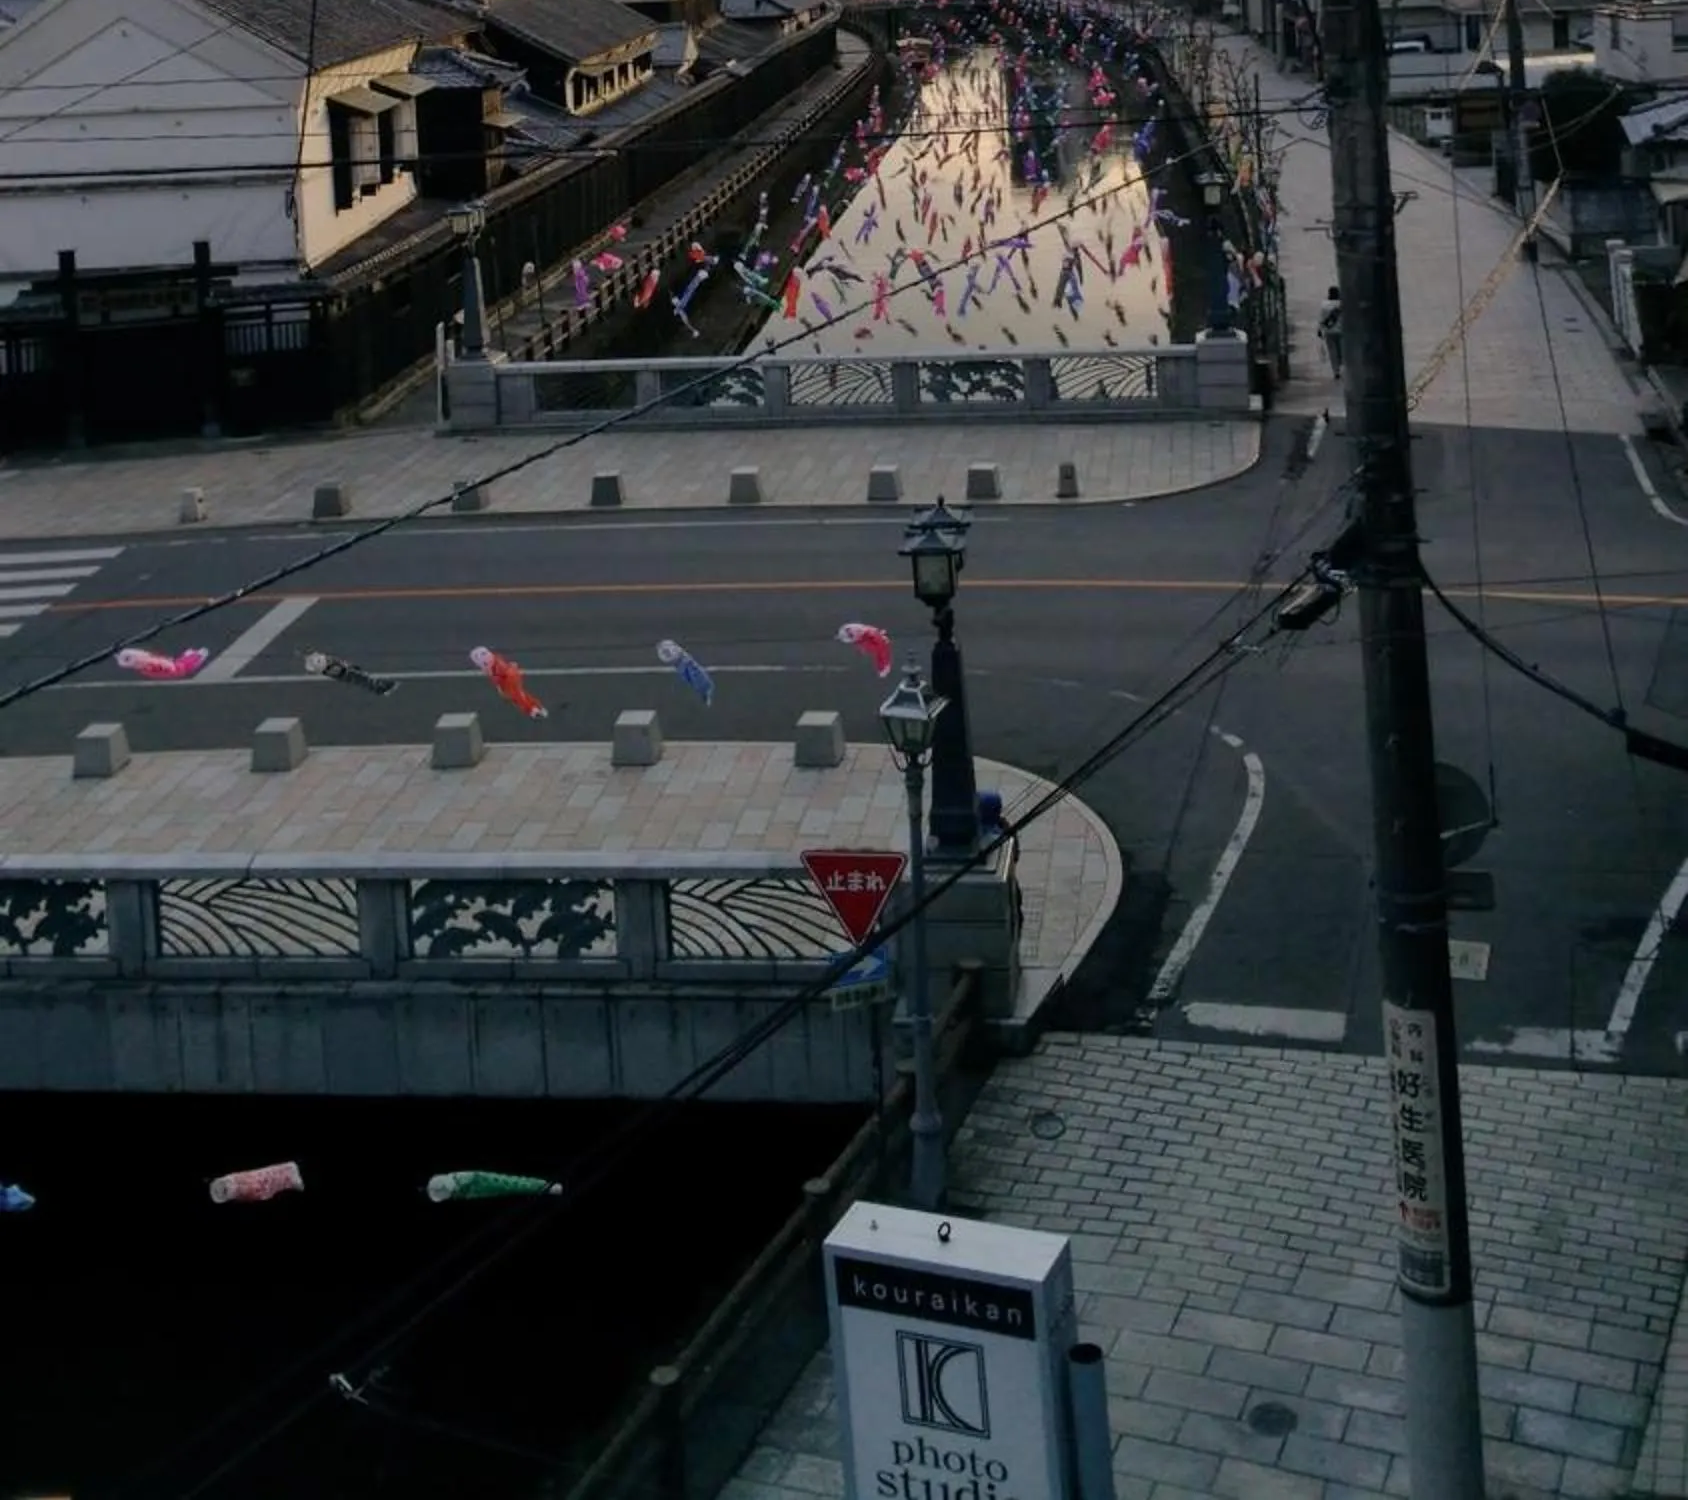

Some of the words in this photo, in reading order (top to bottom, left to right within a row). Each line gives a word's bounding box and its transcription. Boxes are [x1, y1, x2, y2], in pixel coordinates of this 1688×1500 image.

[826, 870, 886, 892] 止まれ
[853, 1274, 1023, 1327] kouraikan
[891, 1436, 1009, 1482] photo
[876, 1466, 1022, 1500] studi
